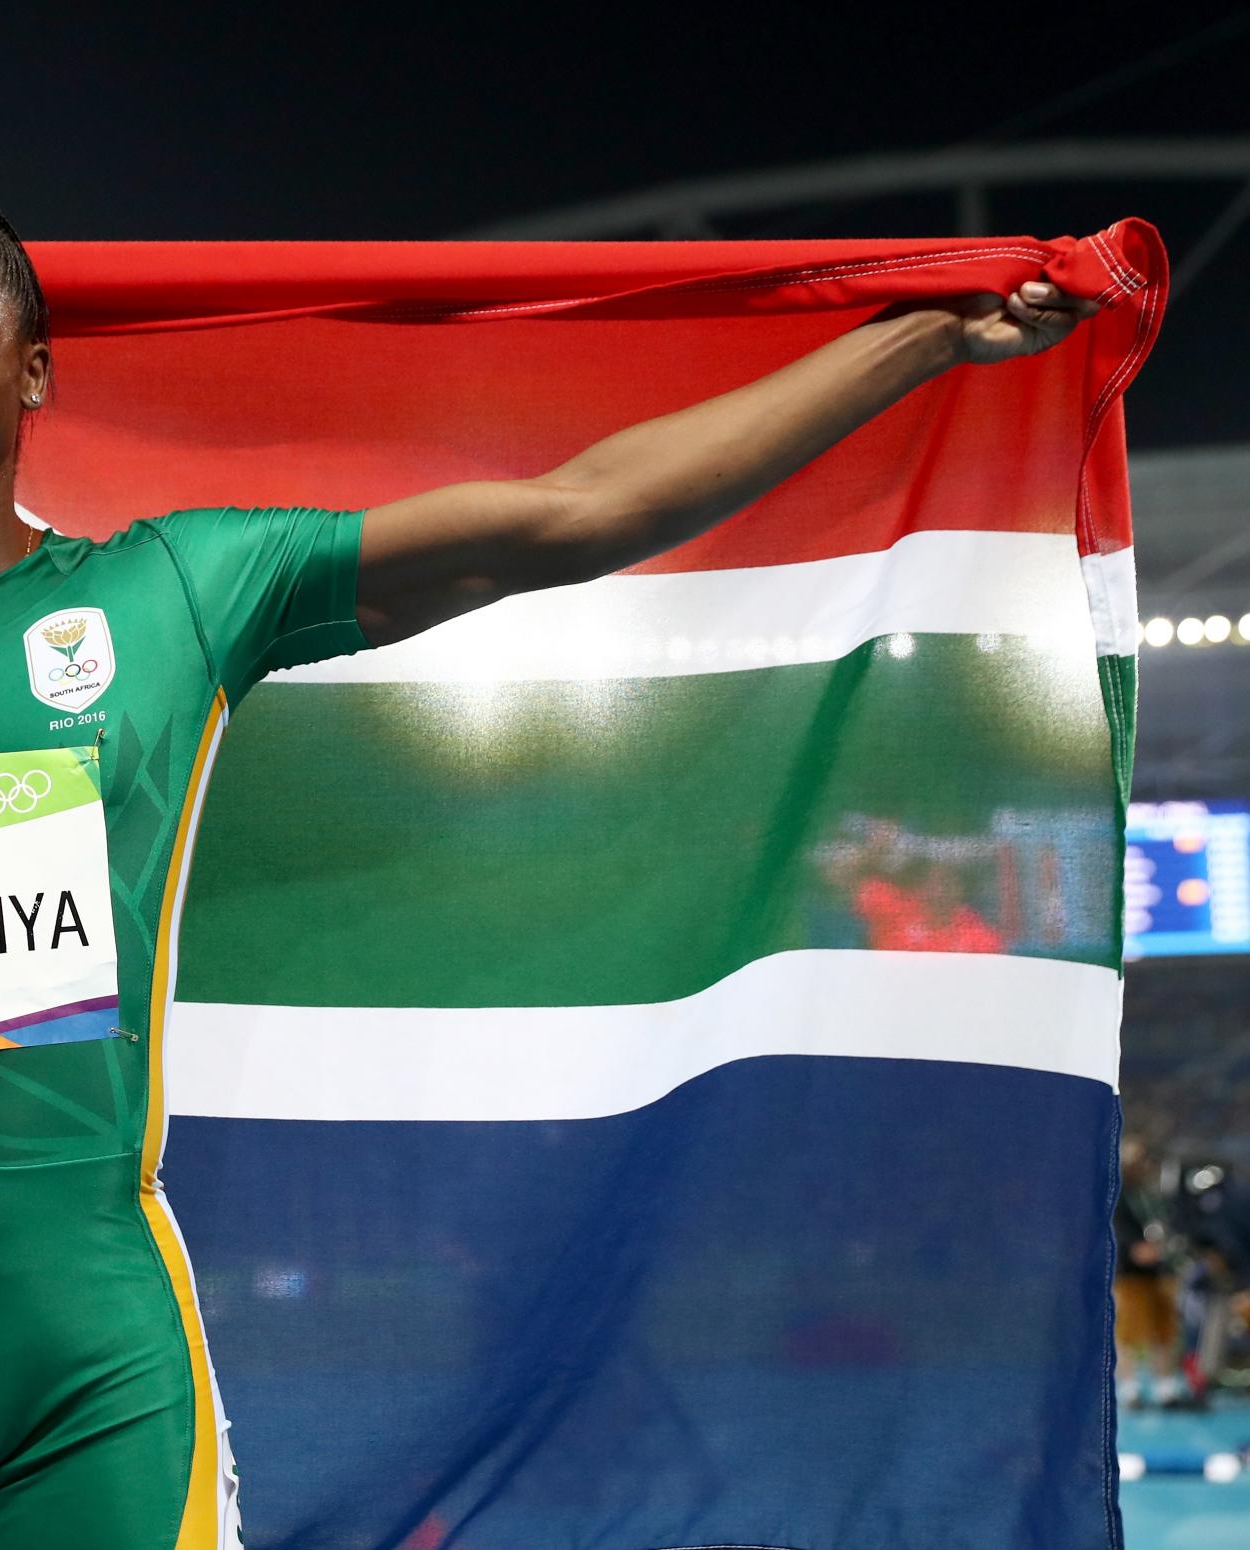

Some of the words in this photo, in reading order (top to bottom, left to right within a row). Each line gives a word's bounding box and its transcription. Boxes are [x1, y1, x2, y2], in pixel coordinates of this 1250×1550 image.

[49, 688, 74, 699] SOUTH
[75, 682, 101, 692] AFRICA
[49, 717, 74, 731] RIO
[77, 711, 106, 725] 2016
